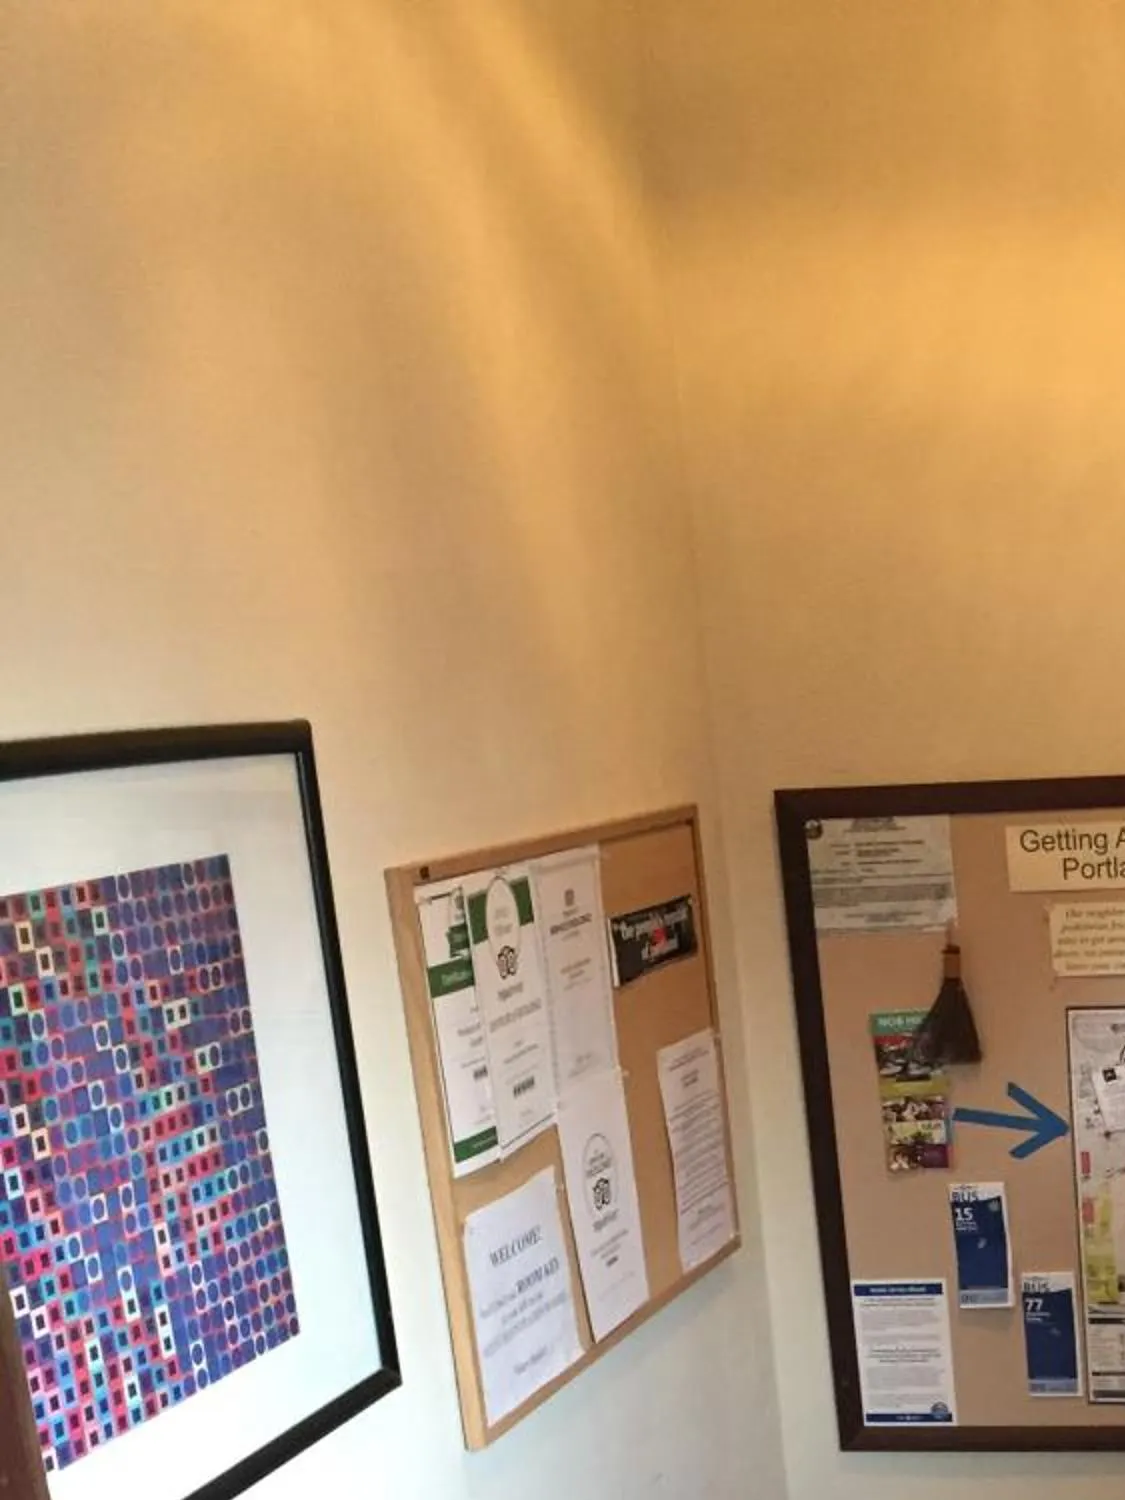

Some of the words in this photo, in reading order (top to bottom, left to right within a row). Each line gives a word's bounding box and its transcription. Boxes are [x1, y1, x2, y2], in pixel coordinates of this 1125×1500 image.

[1020, 828, 1108, 855] Getting
[954, 1207, 974, 1221] 15
[1025, 1298, 1043, 1313] 77
